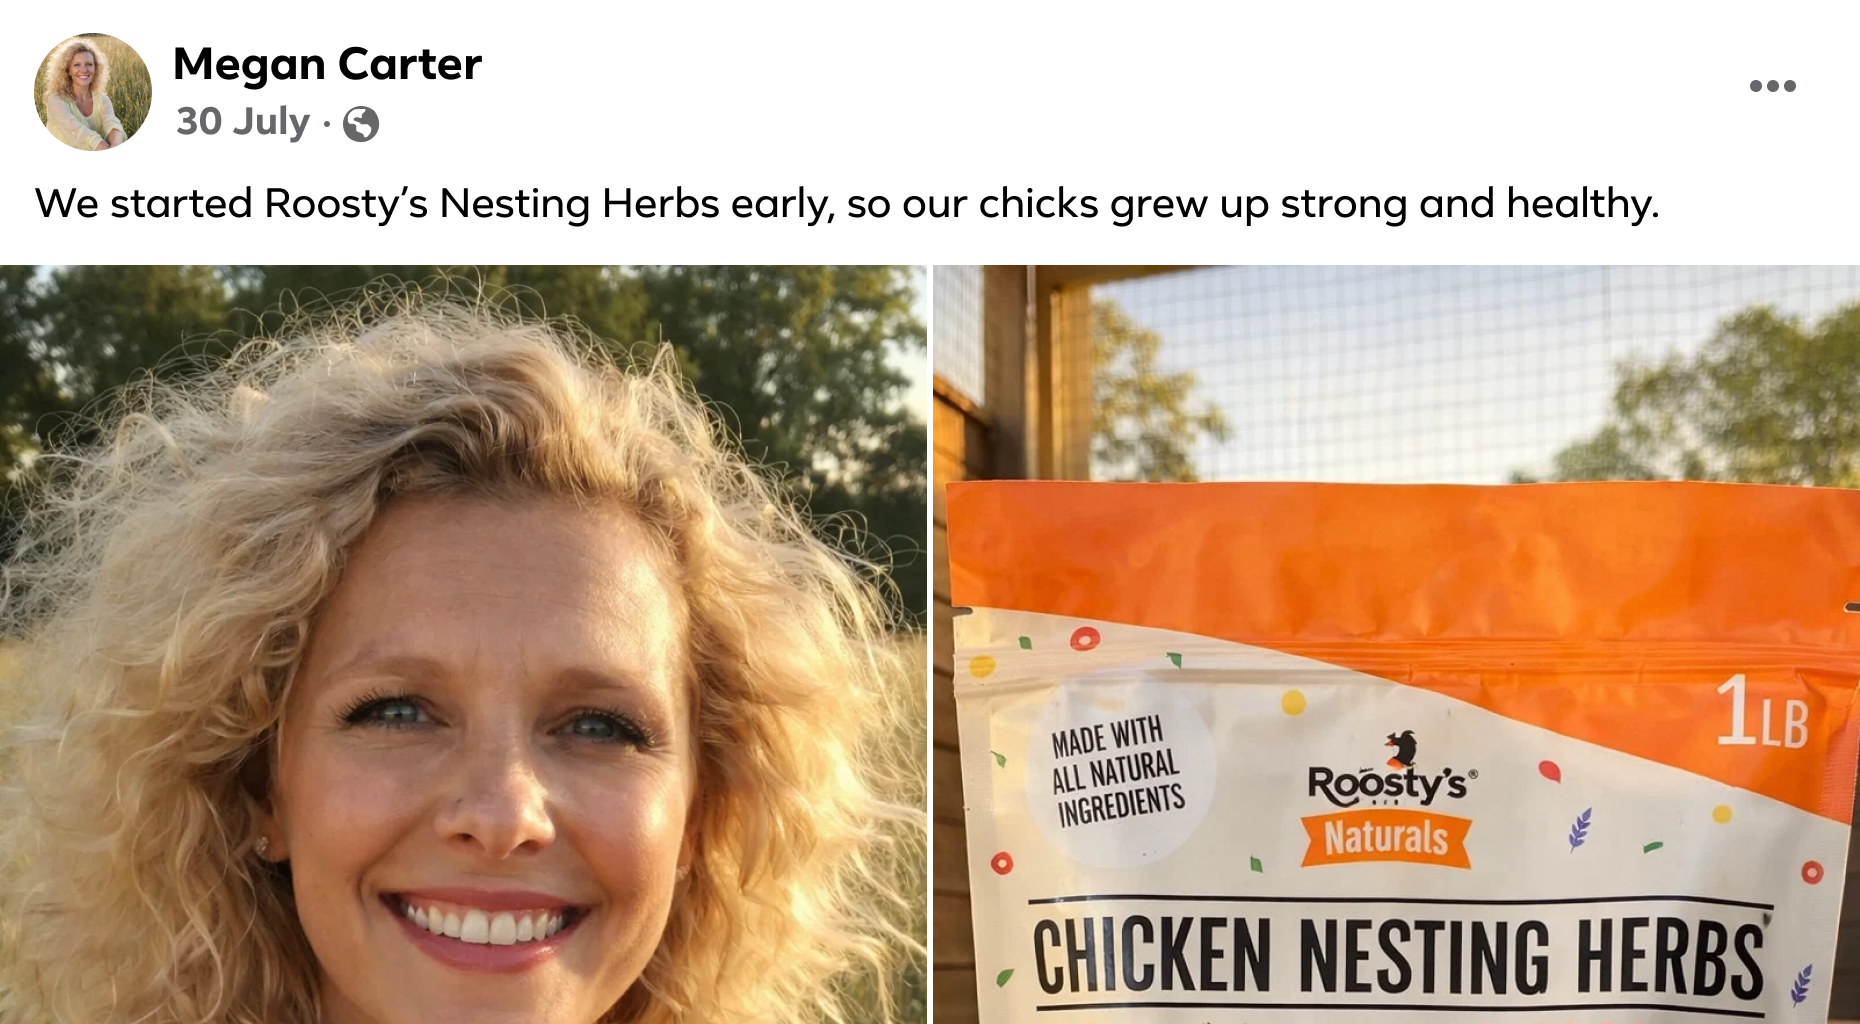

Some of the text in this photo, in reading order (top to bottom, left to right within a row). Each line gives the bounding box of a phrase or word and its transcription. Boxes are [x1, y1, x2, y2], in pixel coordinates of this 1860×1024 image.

[1051, 714, 1164, 759] MADE WITH
[1052, 748, 1180, 795] ALL NATURAL
[1057, 782, 1186, 828] INGREDIENTS
[1324, 819, 1448, 856] Naturals
[1034, 916, 1764, 1001] CHICKEN NESTING HERBS
